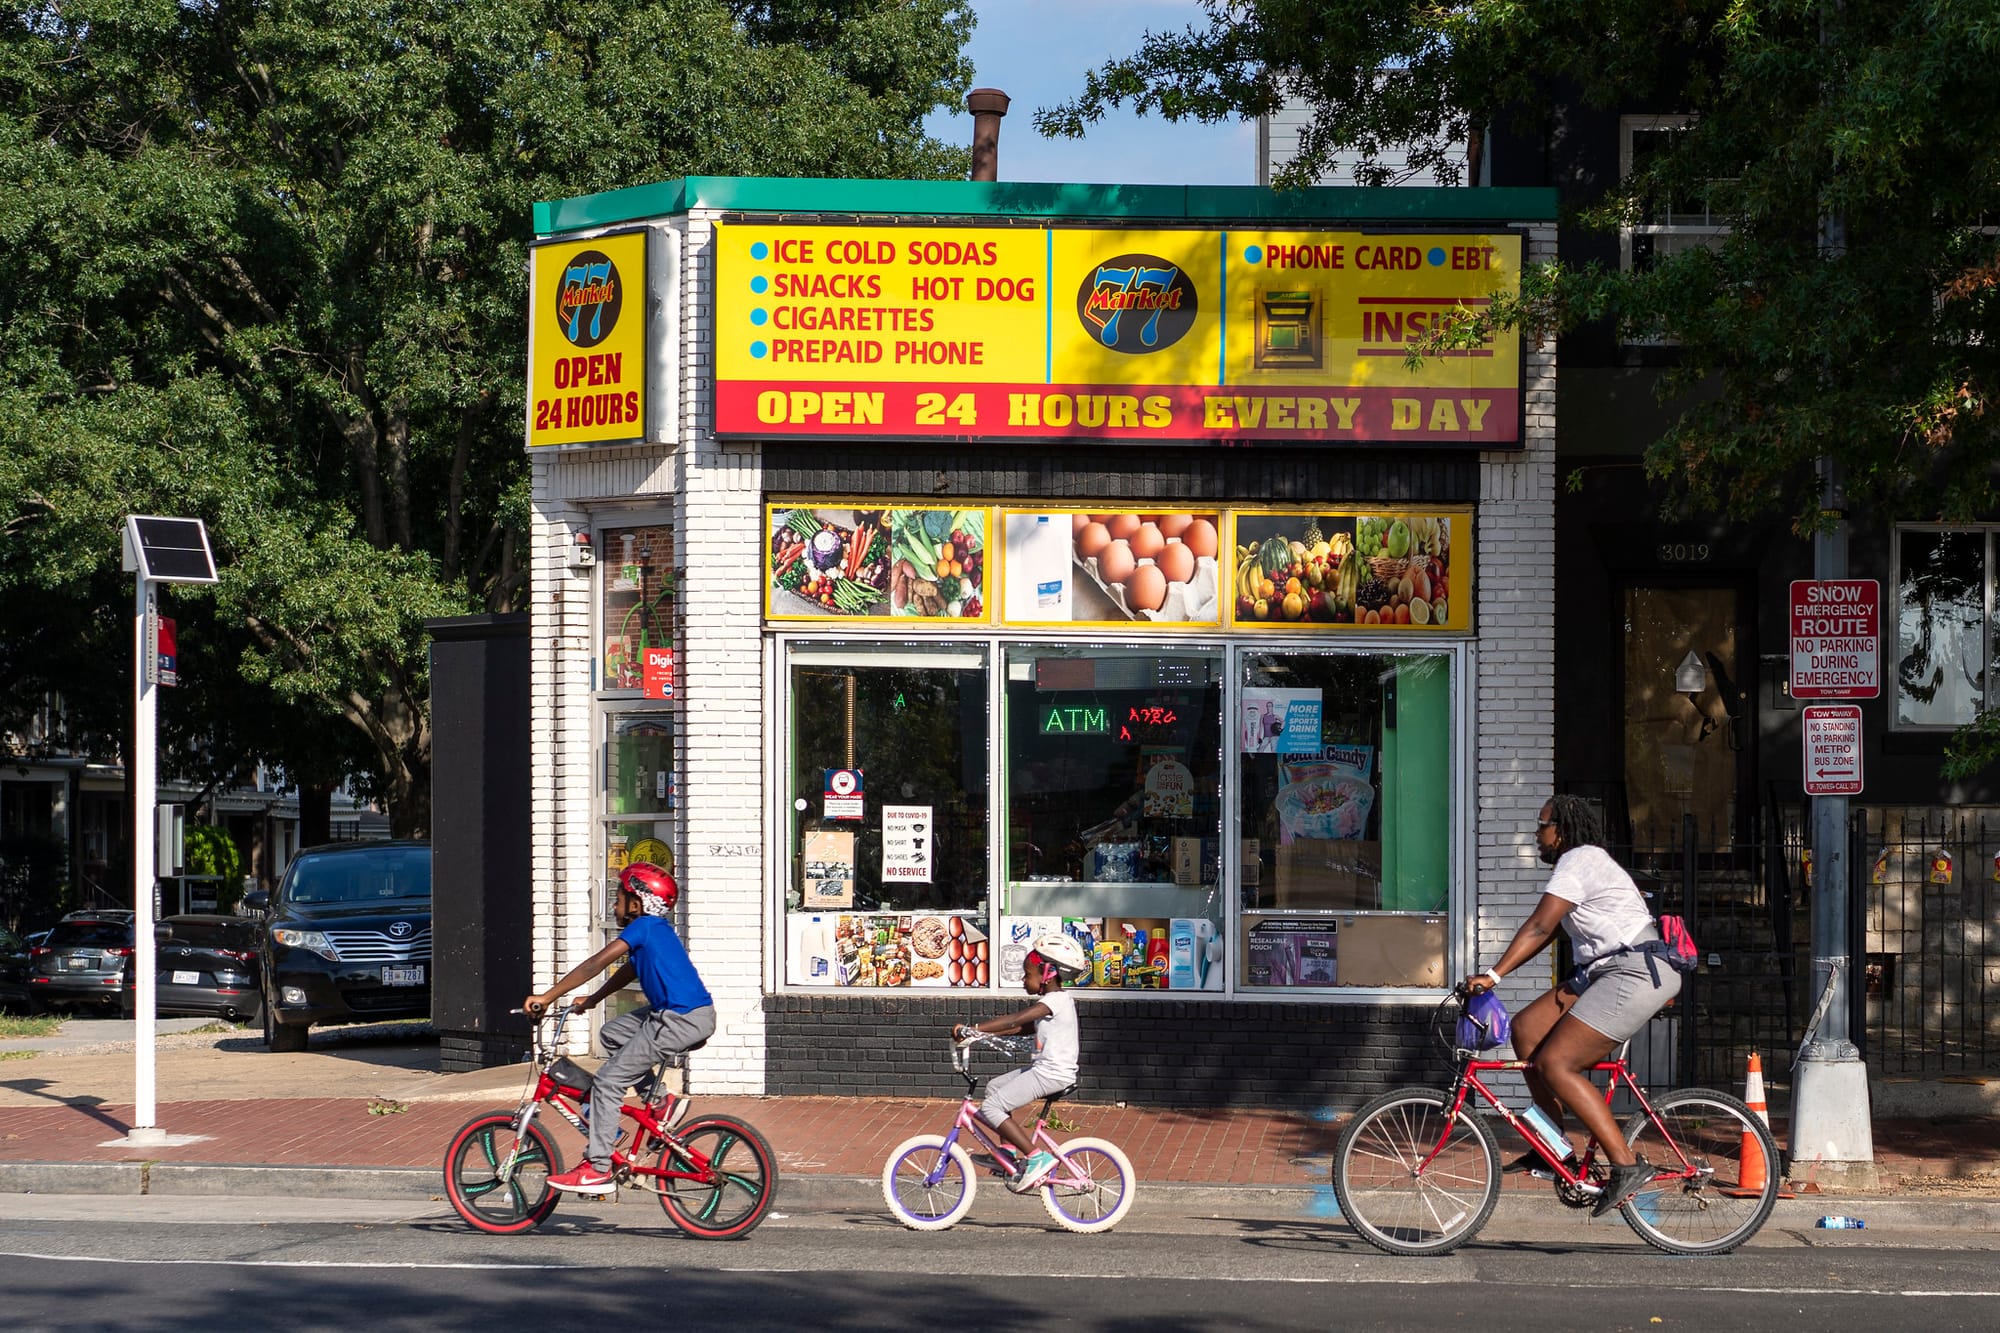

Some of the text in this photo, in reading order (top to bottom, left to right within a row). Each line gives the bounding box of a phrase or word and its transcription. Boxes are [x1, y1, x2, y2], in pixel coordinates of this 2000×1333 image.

[775, 240, 997, 265] ICE COLD SODAS
[1267, 245, 1492, 270] PHONE CARD EBT
[775, 274, 1034, 301] SNACKS HOT DOG
[559, 280, 615, 324] Market
[565, 260, 612, 342] 77
[1084, 287, 1183, 328] Market
[1094, 266, 1178, 346] 77
[774, 306, 933, 331] CIGARETTES
[1363, 311, 1493, 343] INSI
[773, 340, 982, 364] PREPAID PHONE
[555, 353, 622, 389] OPEN
[536, 391, 638, 430] 24 HOURS
[758, 391, 1491, 431] OPEN 24 HOURS EVERY DAY
[1662, 544, 1709, 560] 3019
[1807, 586, 1862, 603] SNOW
[1795, 604, 1874, 616] EMERGENCY
[1801, 619, 1868, 635] ROUTE
[1796, 639, 1874, 653] NO PARKING
[1811, 655, 1858, 669] DURING
[1796, 672, 1873, 685] EMERGENCY
[1289, 705, 1319, 713] MORE
[1046, 709, 1104, 732] ATM
[1289, 725, 1318, 733] DRINK
[1810, 722, 1855, 731] NO STANDING
[1811, 734, 1855, 743] OR PARKING
[1326, 746, 1366, 770] Candy
[1815, 745, 1851, 754] METRO
[1814, 756, 1854, 766] BUS ZONE
[887, 811, 897, 819] DUE
[898, 811, 905, 819] TO
[887, 867, 927, 876] NO SERVICE
[384, 970, 421, 981] FH 7287
